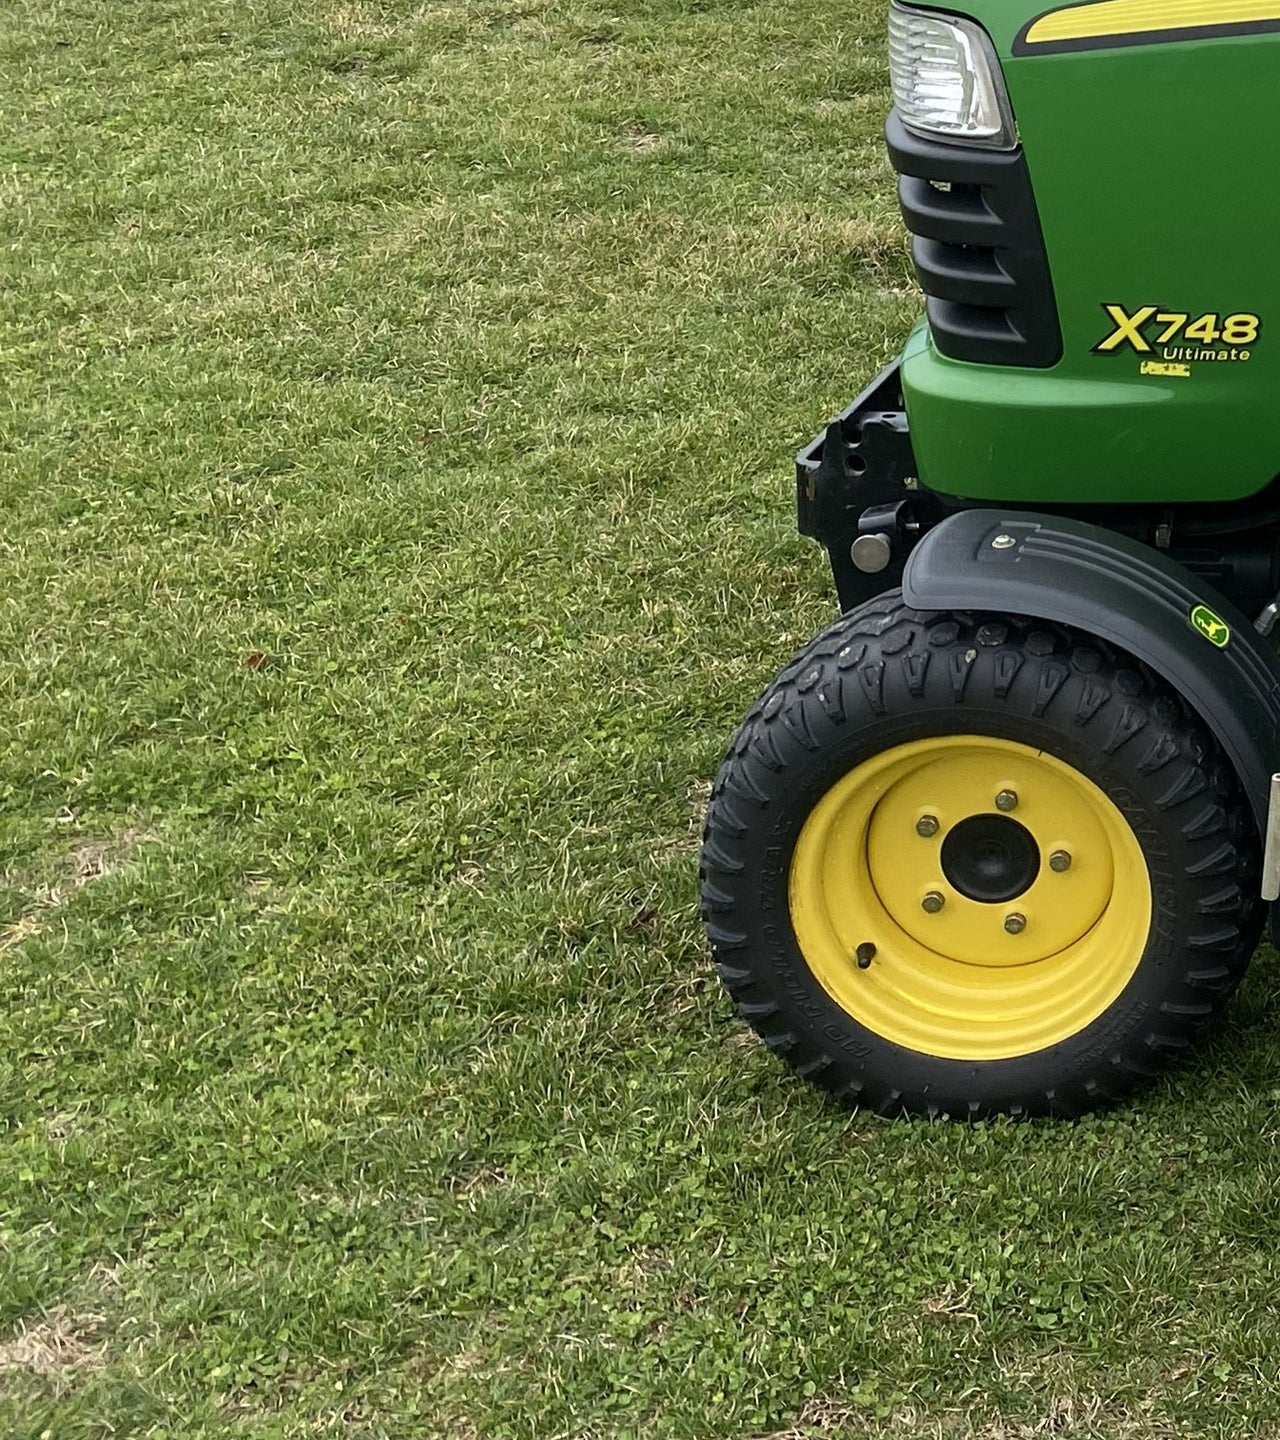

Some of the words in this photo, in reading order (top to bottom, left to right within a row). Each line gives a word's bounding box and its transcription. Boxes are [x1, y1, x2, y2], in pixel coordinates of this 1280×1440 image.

[1095, 304, 1261, 353] X748
[1162, 347, 1252, 362] Ultimate
[822, 1022, 872, 1058] HD
